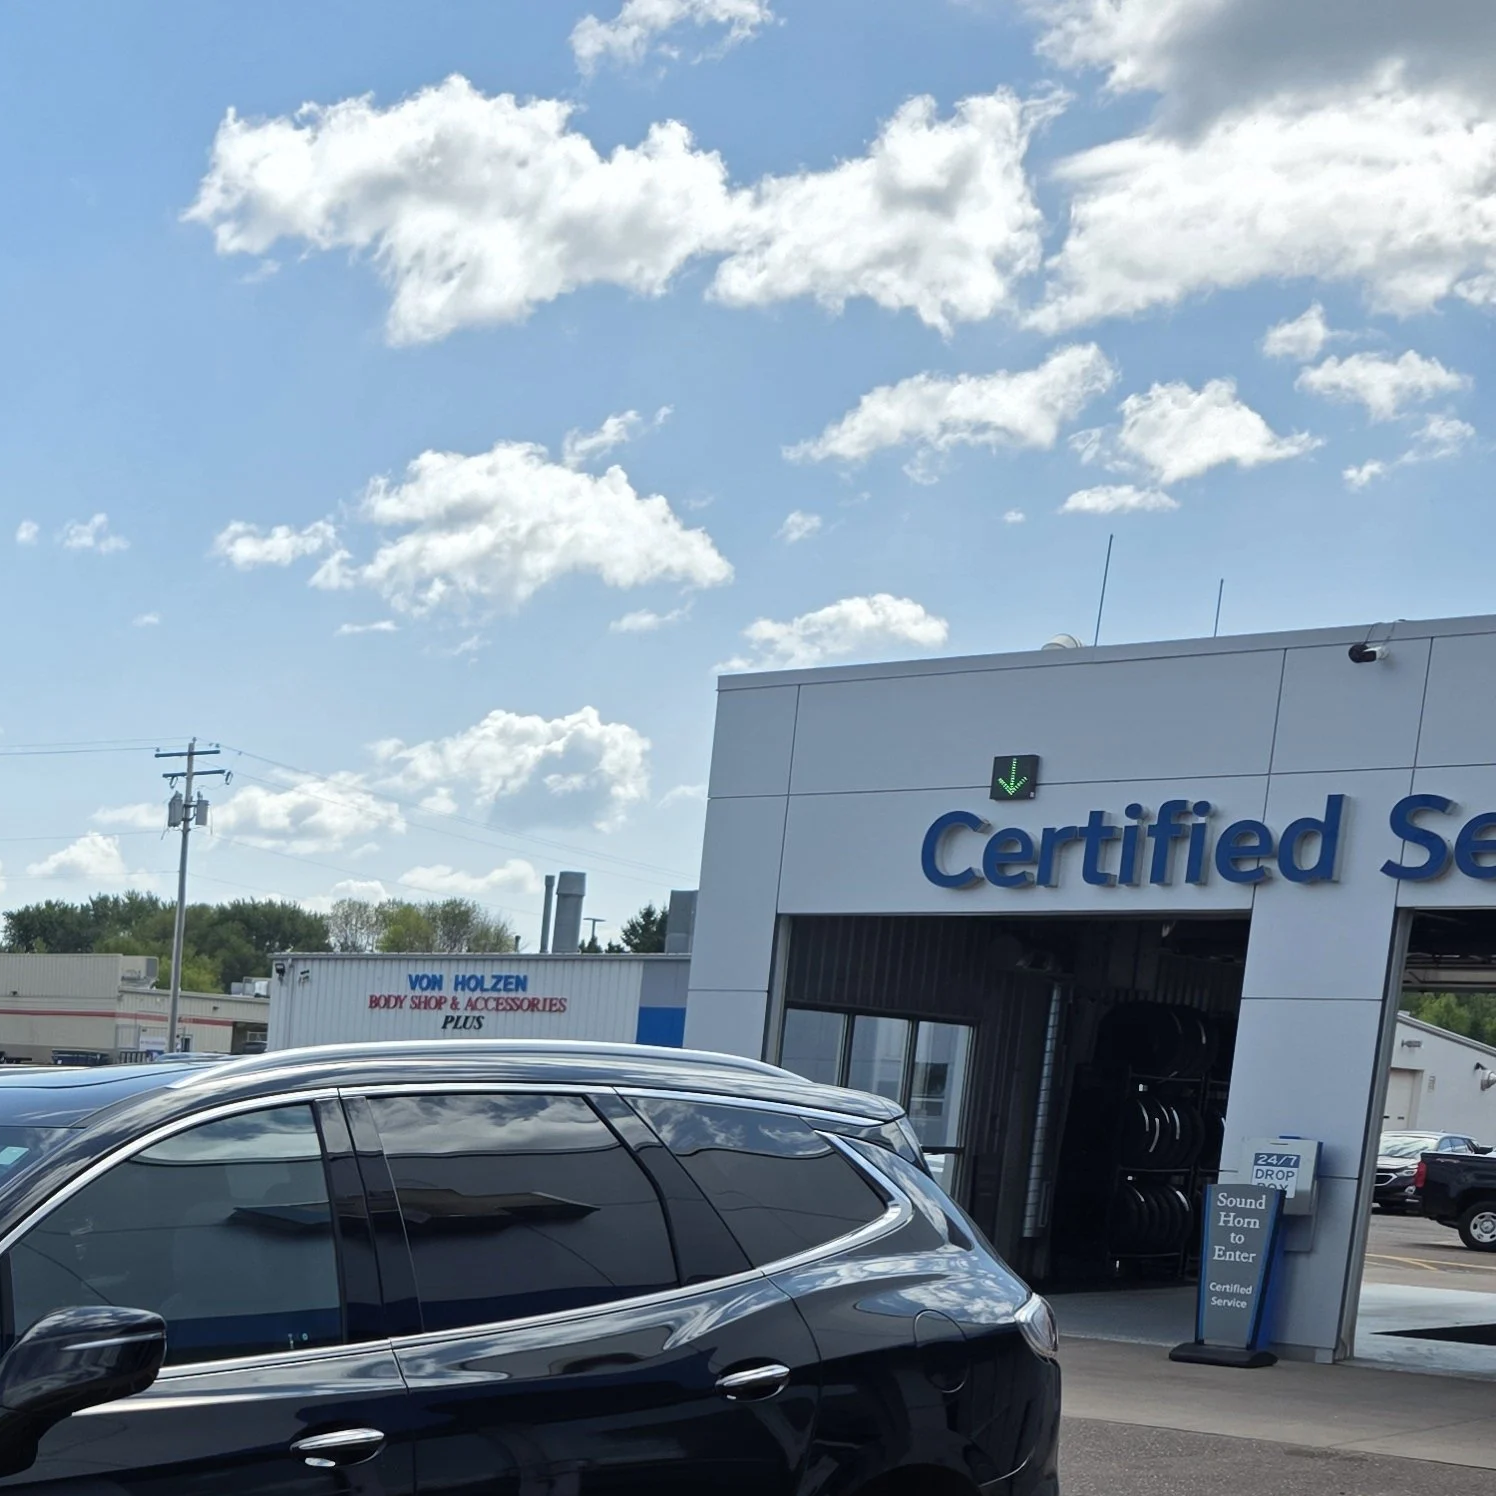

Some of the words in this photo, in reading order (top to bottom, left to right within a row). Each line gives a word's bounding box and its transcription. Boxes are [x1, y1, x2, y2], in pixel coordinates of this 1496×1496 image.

[920, 794, 1347, 890] Certified
[1380, 793, 1496, 881] Se
[408, 973, 444, 992] VON
[454, 974, 529, 993] HOLZEN
[368, 994, 407, 1010] BODY
[409, 995, 448, 1011] SHOP
[449, 997, 460, 1011] &
[464, 997, 568, 1013] ACCESSORIES
[441, 1014, 485, 1030] PLUS
[1257, 1154, 1298, 1166] 24/7
[1255, 1168, 1295, 1181] DROP
[1217, 1192, 1266, 1210] Sound
[1218, 1211, 1260, 1228] Horn
[1230, 1232, 1245, 1244] to
[1212, 1245, 1256, 1263] Enter
[1209, 1281, 1253, 1295] Certified
[1210, 1296, 1247, 1309] Service
